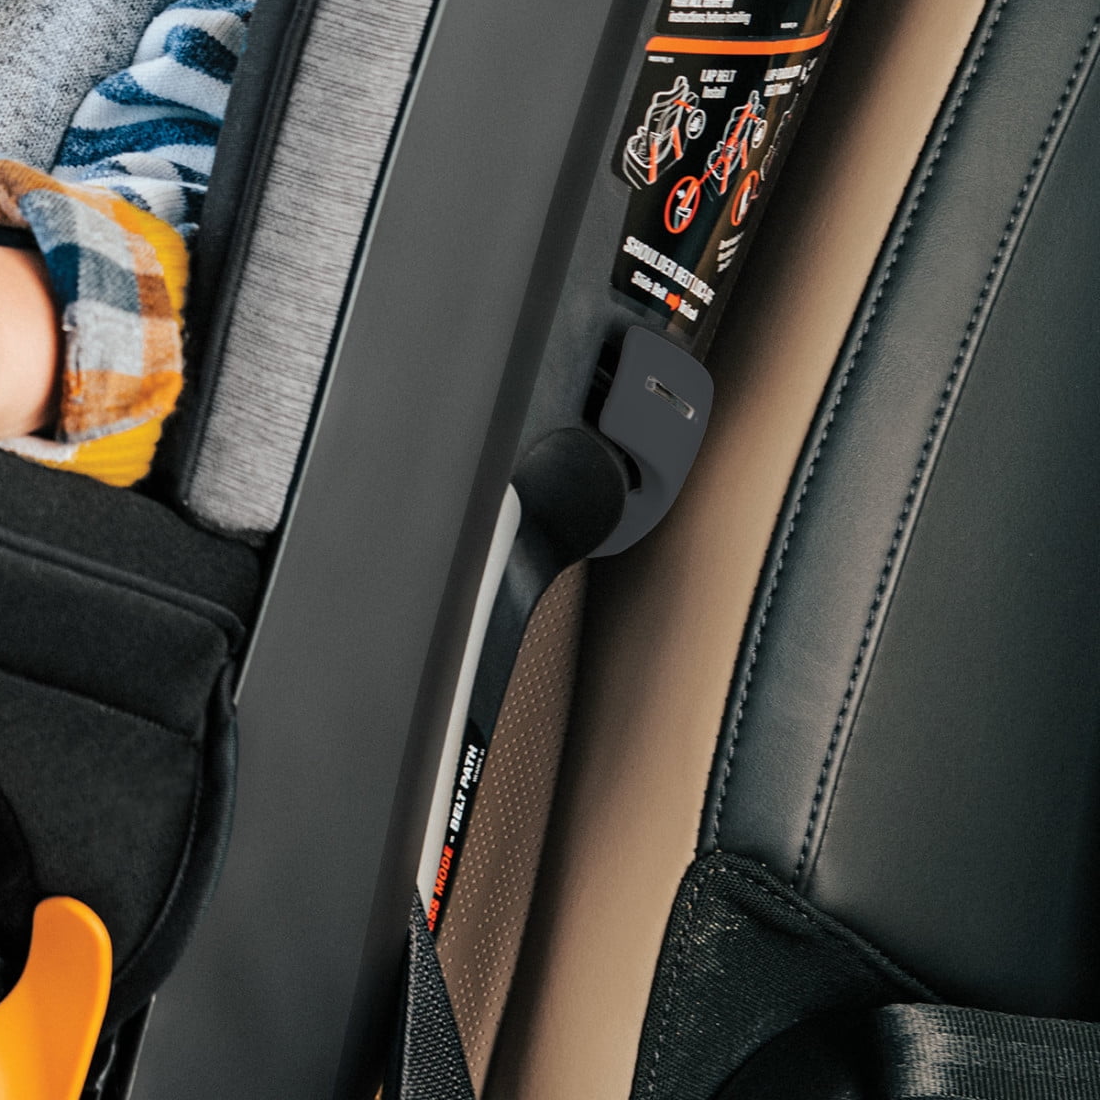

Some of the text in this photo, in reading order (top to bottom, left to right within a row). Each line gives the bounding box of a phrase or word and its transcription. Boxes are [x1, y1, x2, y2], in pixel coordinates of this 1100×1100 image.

[433, 845, 454, 897] MODE
[450, 789, 466, 832] BELT
[460, 744, 478, 789] PATH
